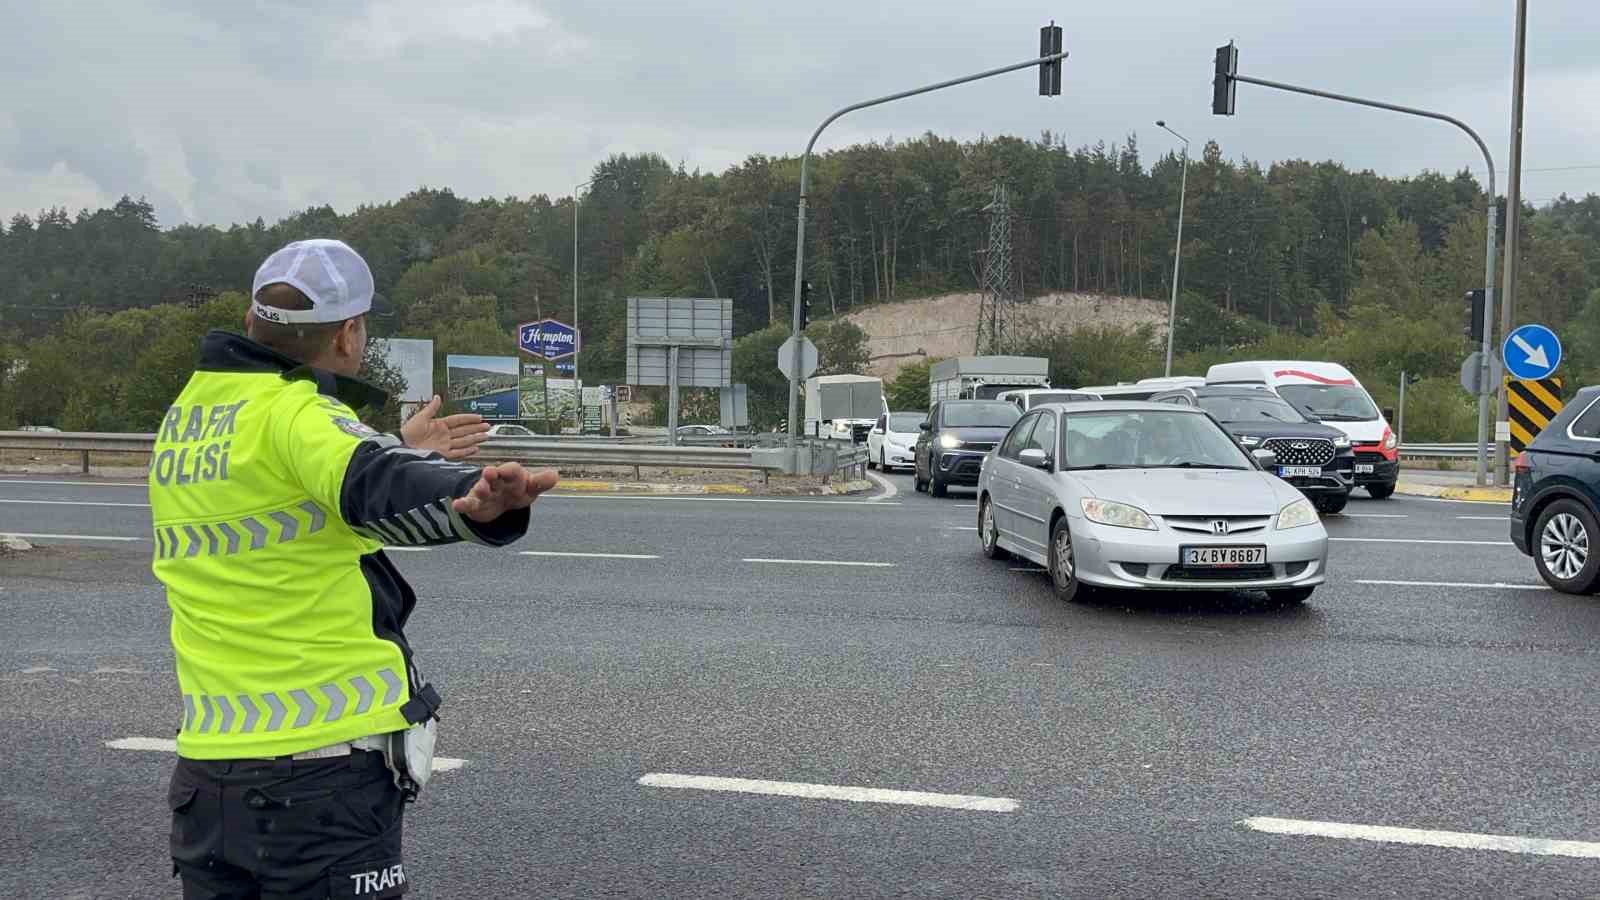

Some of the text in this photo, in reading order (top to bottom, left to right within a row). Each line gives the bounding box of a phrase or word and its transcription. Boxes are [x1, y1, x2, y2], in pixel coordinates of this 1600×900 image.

[148, 440, 232, 486] OLİSİ
[1191, 549, 1261, 563] 34 BV 8687
